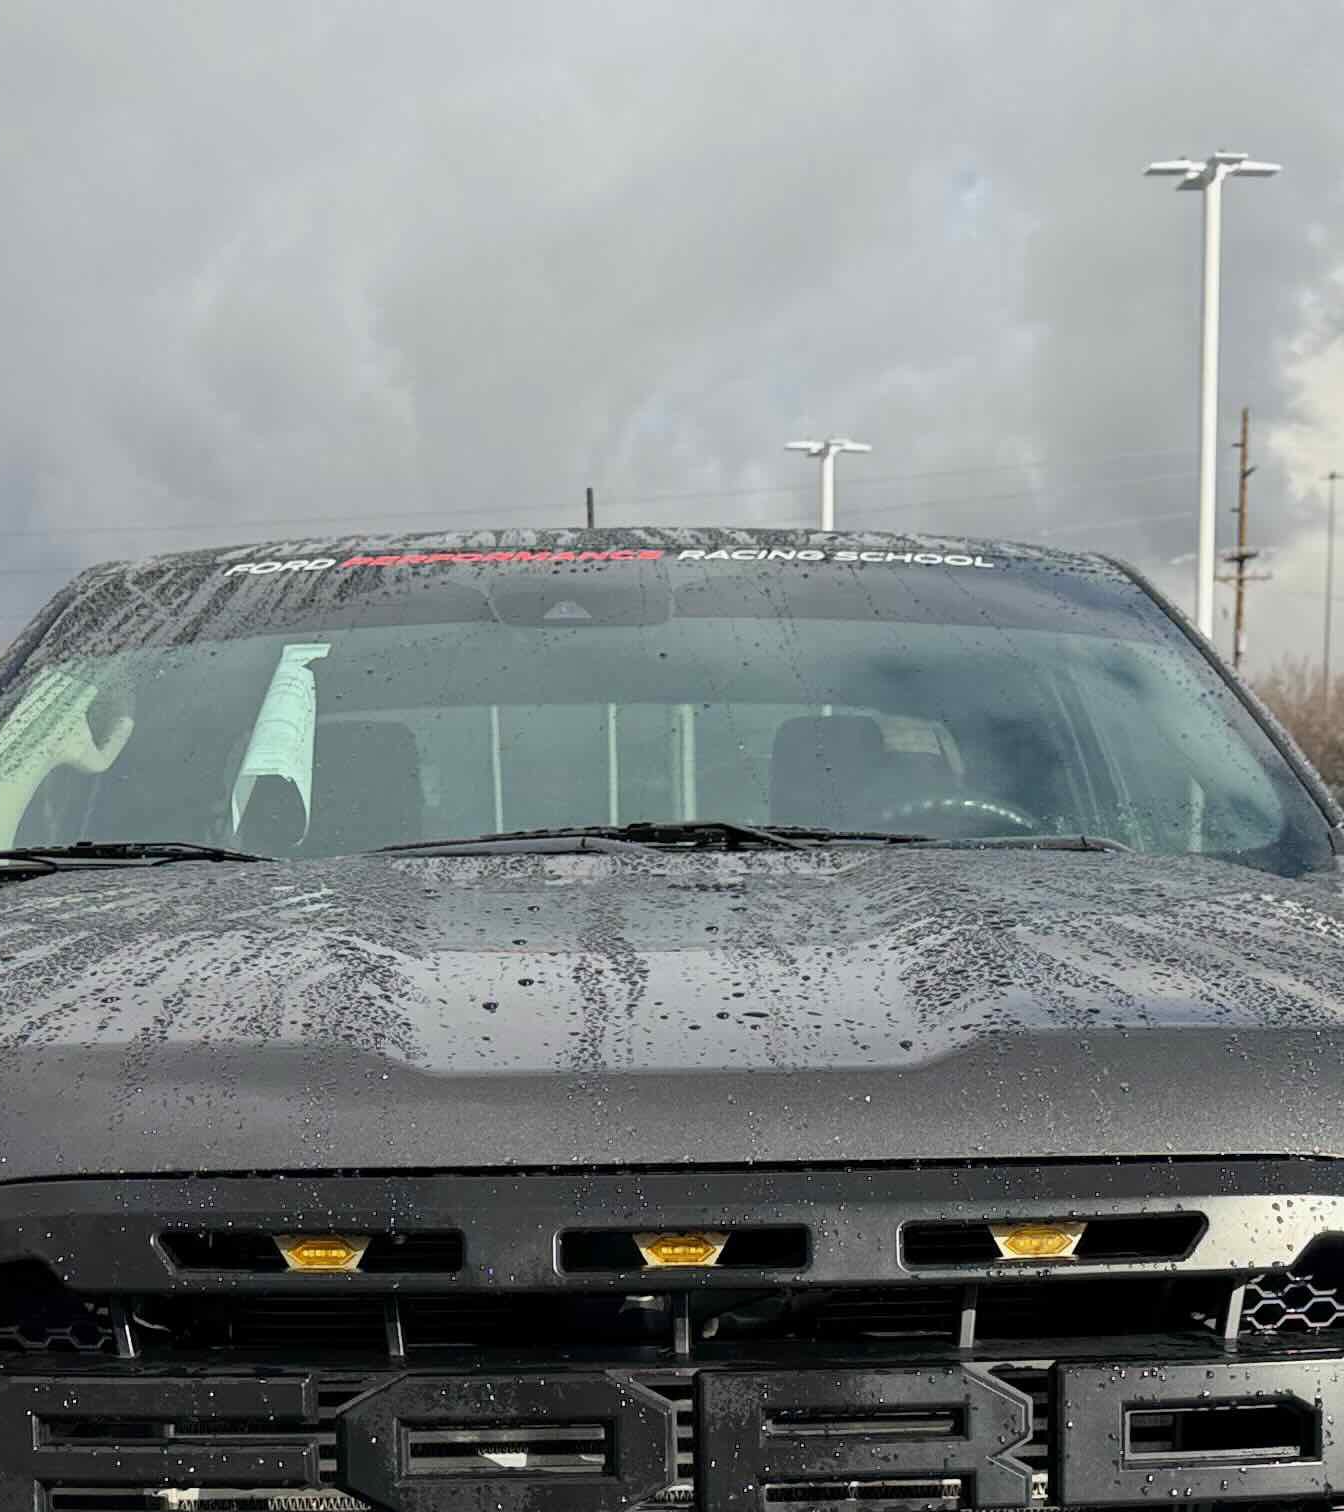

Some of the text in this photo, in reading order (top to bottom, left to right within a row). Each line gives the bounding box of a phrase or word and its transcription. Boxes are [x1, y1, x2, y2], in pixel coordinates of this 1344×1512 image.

[223, 548, 995, 577] FORD PERFORMANCE RACING SCHOOL
